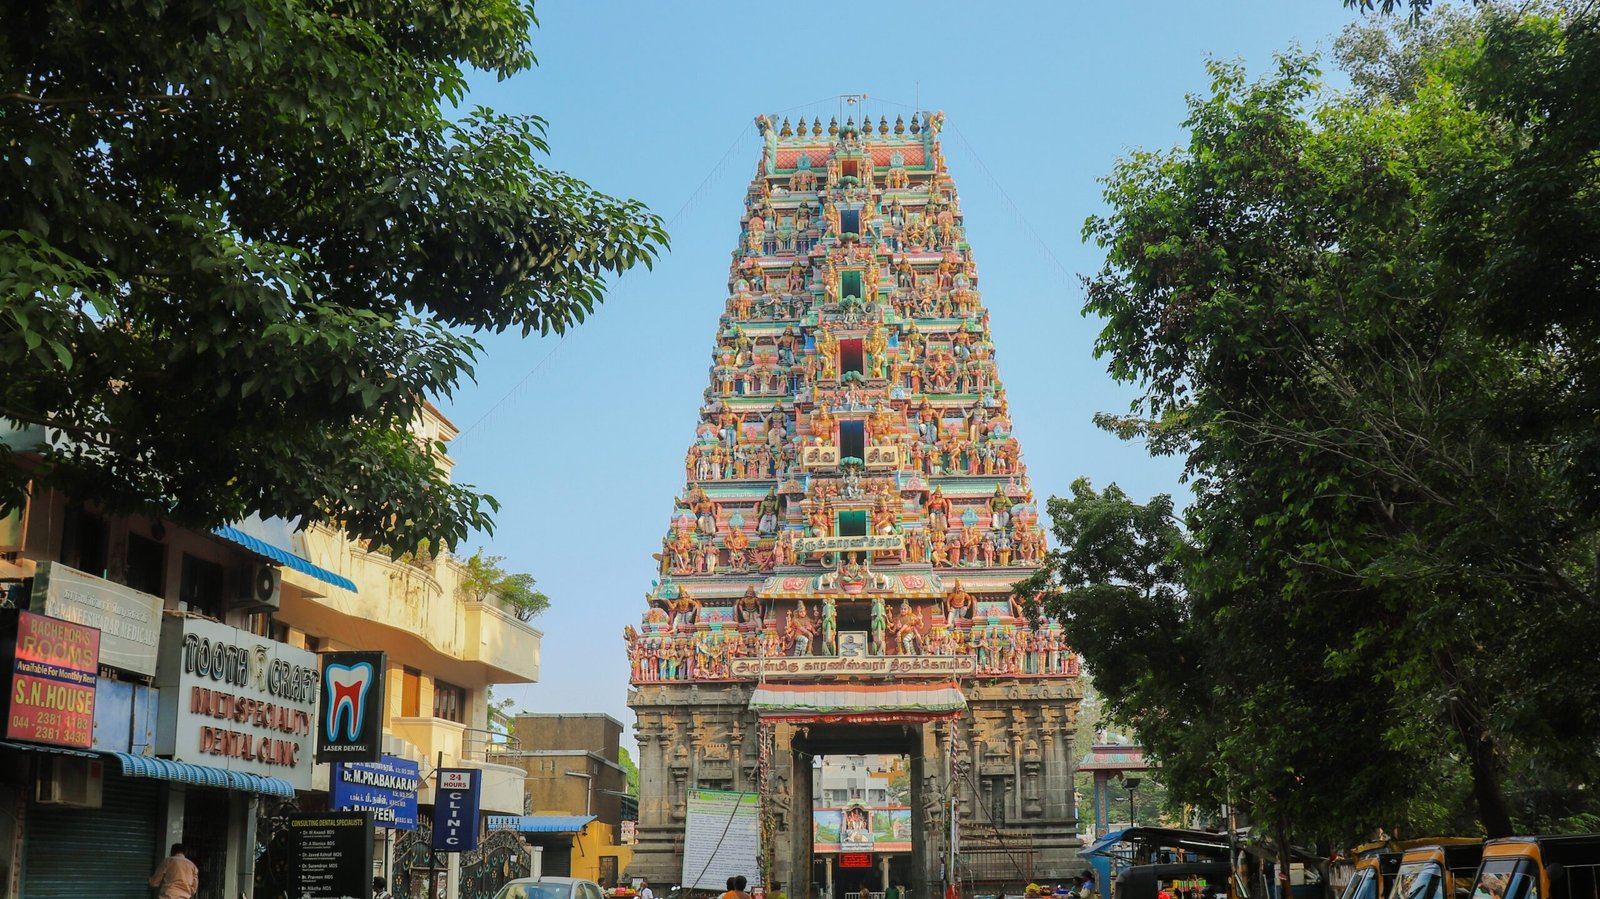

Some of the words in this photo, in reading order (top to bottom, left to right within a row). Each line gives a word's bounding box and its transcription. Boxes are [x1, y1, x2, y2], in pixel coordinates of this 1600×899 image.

[22, 636, 94, 667] ROOMS
[17, 660, 48, 675] Available
[47, 666, 59, 677] For
[58, 668, 82, 683] Monthly
[82, 674, 96, 684] Rent
[182, 632, 249, 687] TOOTH
[268, 657, 321, 704] CRAFT
[15, 679, 92, 714] S.N.HOUSE
[12, 715, 29, 728] 044
[37, 711, 61, 725] 2381
[34, 726, 60, 740] 2381
[63, 730, 87, 743] 3438
[199, 725, 256, 761] DENTAL
[257, 736, 300, 768] CLINIC
[343, 770, 353, 782] Dr.
[319, 819, 336, 827] DENTAL
[336, 818, 363, 826] SPECIALISTS
[446, 792, 462, 845] CLINIC
